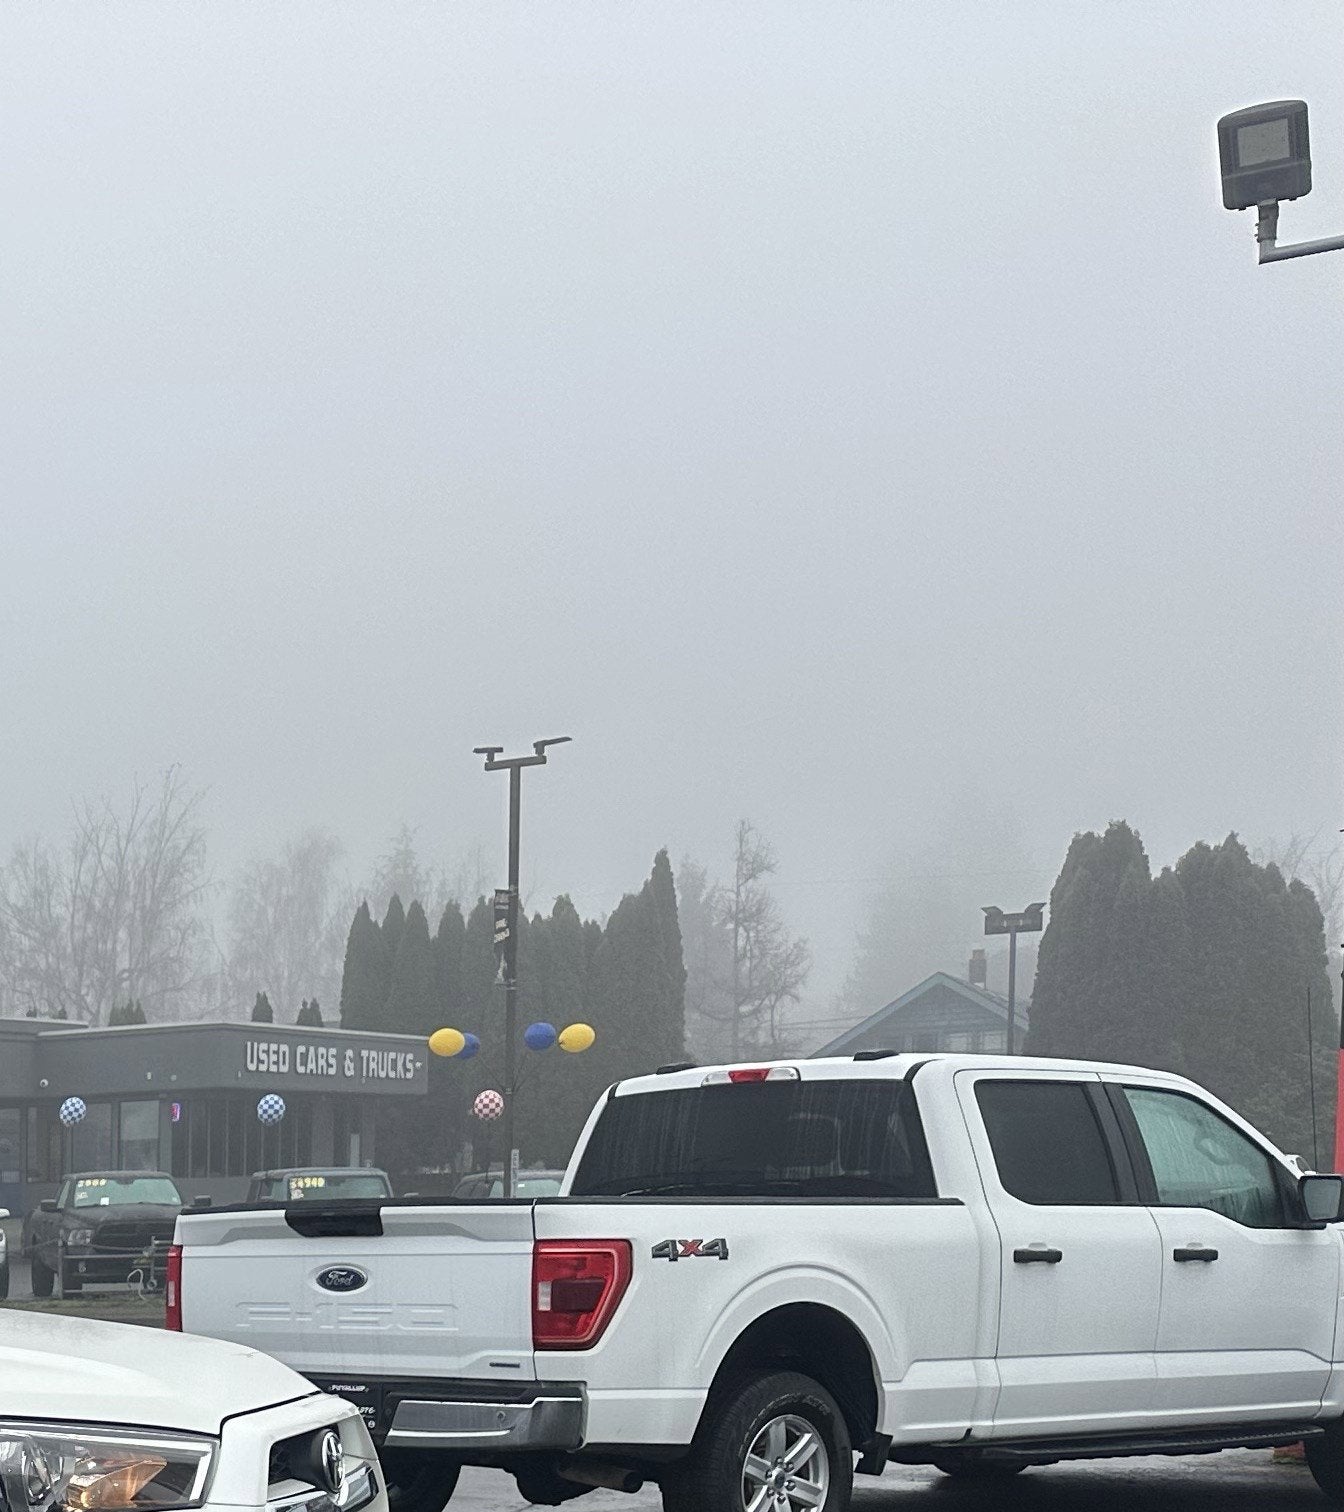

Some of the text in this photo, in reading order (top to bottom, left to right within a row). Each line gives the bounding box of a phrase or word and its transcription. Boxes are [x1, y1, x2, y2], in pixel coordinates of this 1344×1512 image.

[246, 1041, 414, 1079] USED CARS & TRUCKS
